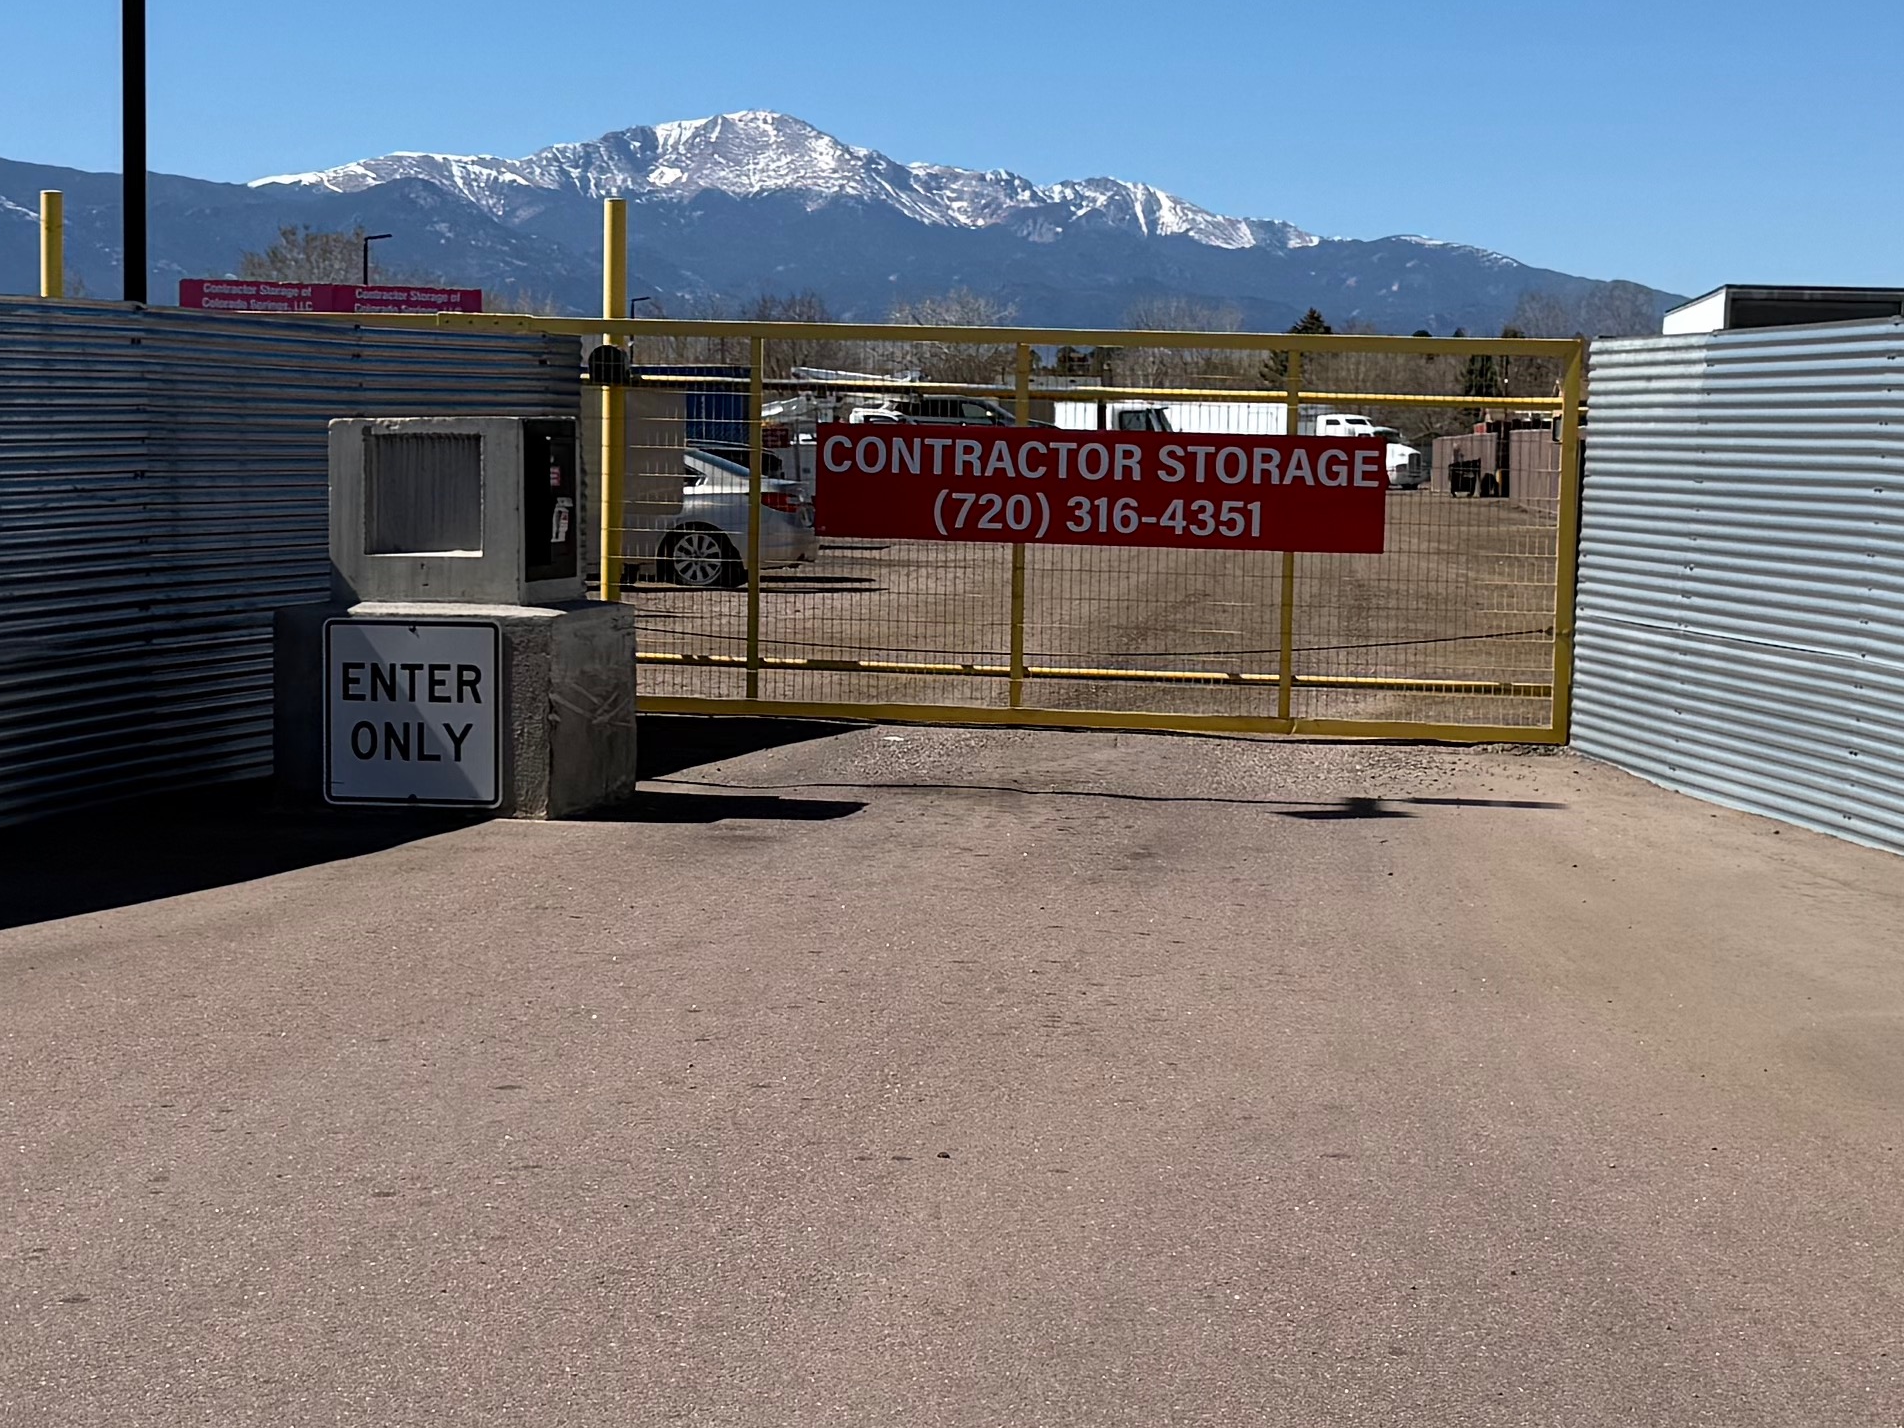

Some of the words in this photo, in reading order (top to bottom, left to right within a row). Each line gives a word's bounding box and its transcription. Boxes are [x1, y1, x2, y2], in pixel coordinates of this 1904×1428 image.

[202, 297, 248, 309] Colorado
[294, 301, 313, 311] LLC
[203, 283, 257, 295] Contractor
[259, 284, 299, 298] Storage
[301, 286, 312, 297] of
[356, 289, 407, 300] Contractor
[410, 290, 449, 304] Storage
[451, 292, 461, 302] of
[823, 435, 1142, 481] CONTRACTOR
[1157, 444, 1380, 487] STORAGE
[933, 489, 1050, 539] (720)
[1066, 496, 1261, 537] 316-4351
[342, 662, 482, 704] ENTER
[351, 720, 474, 762] ONLY
